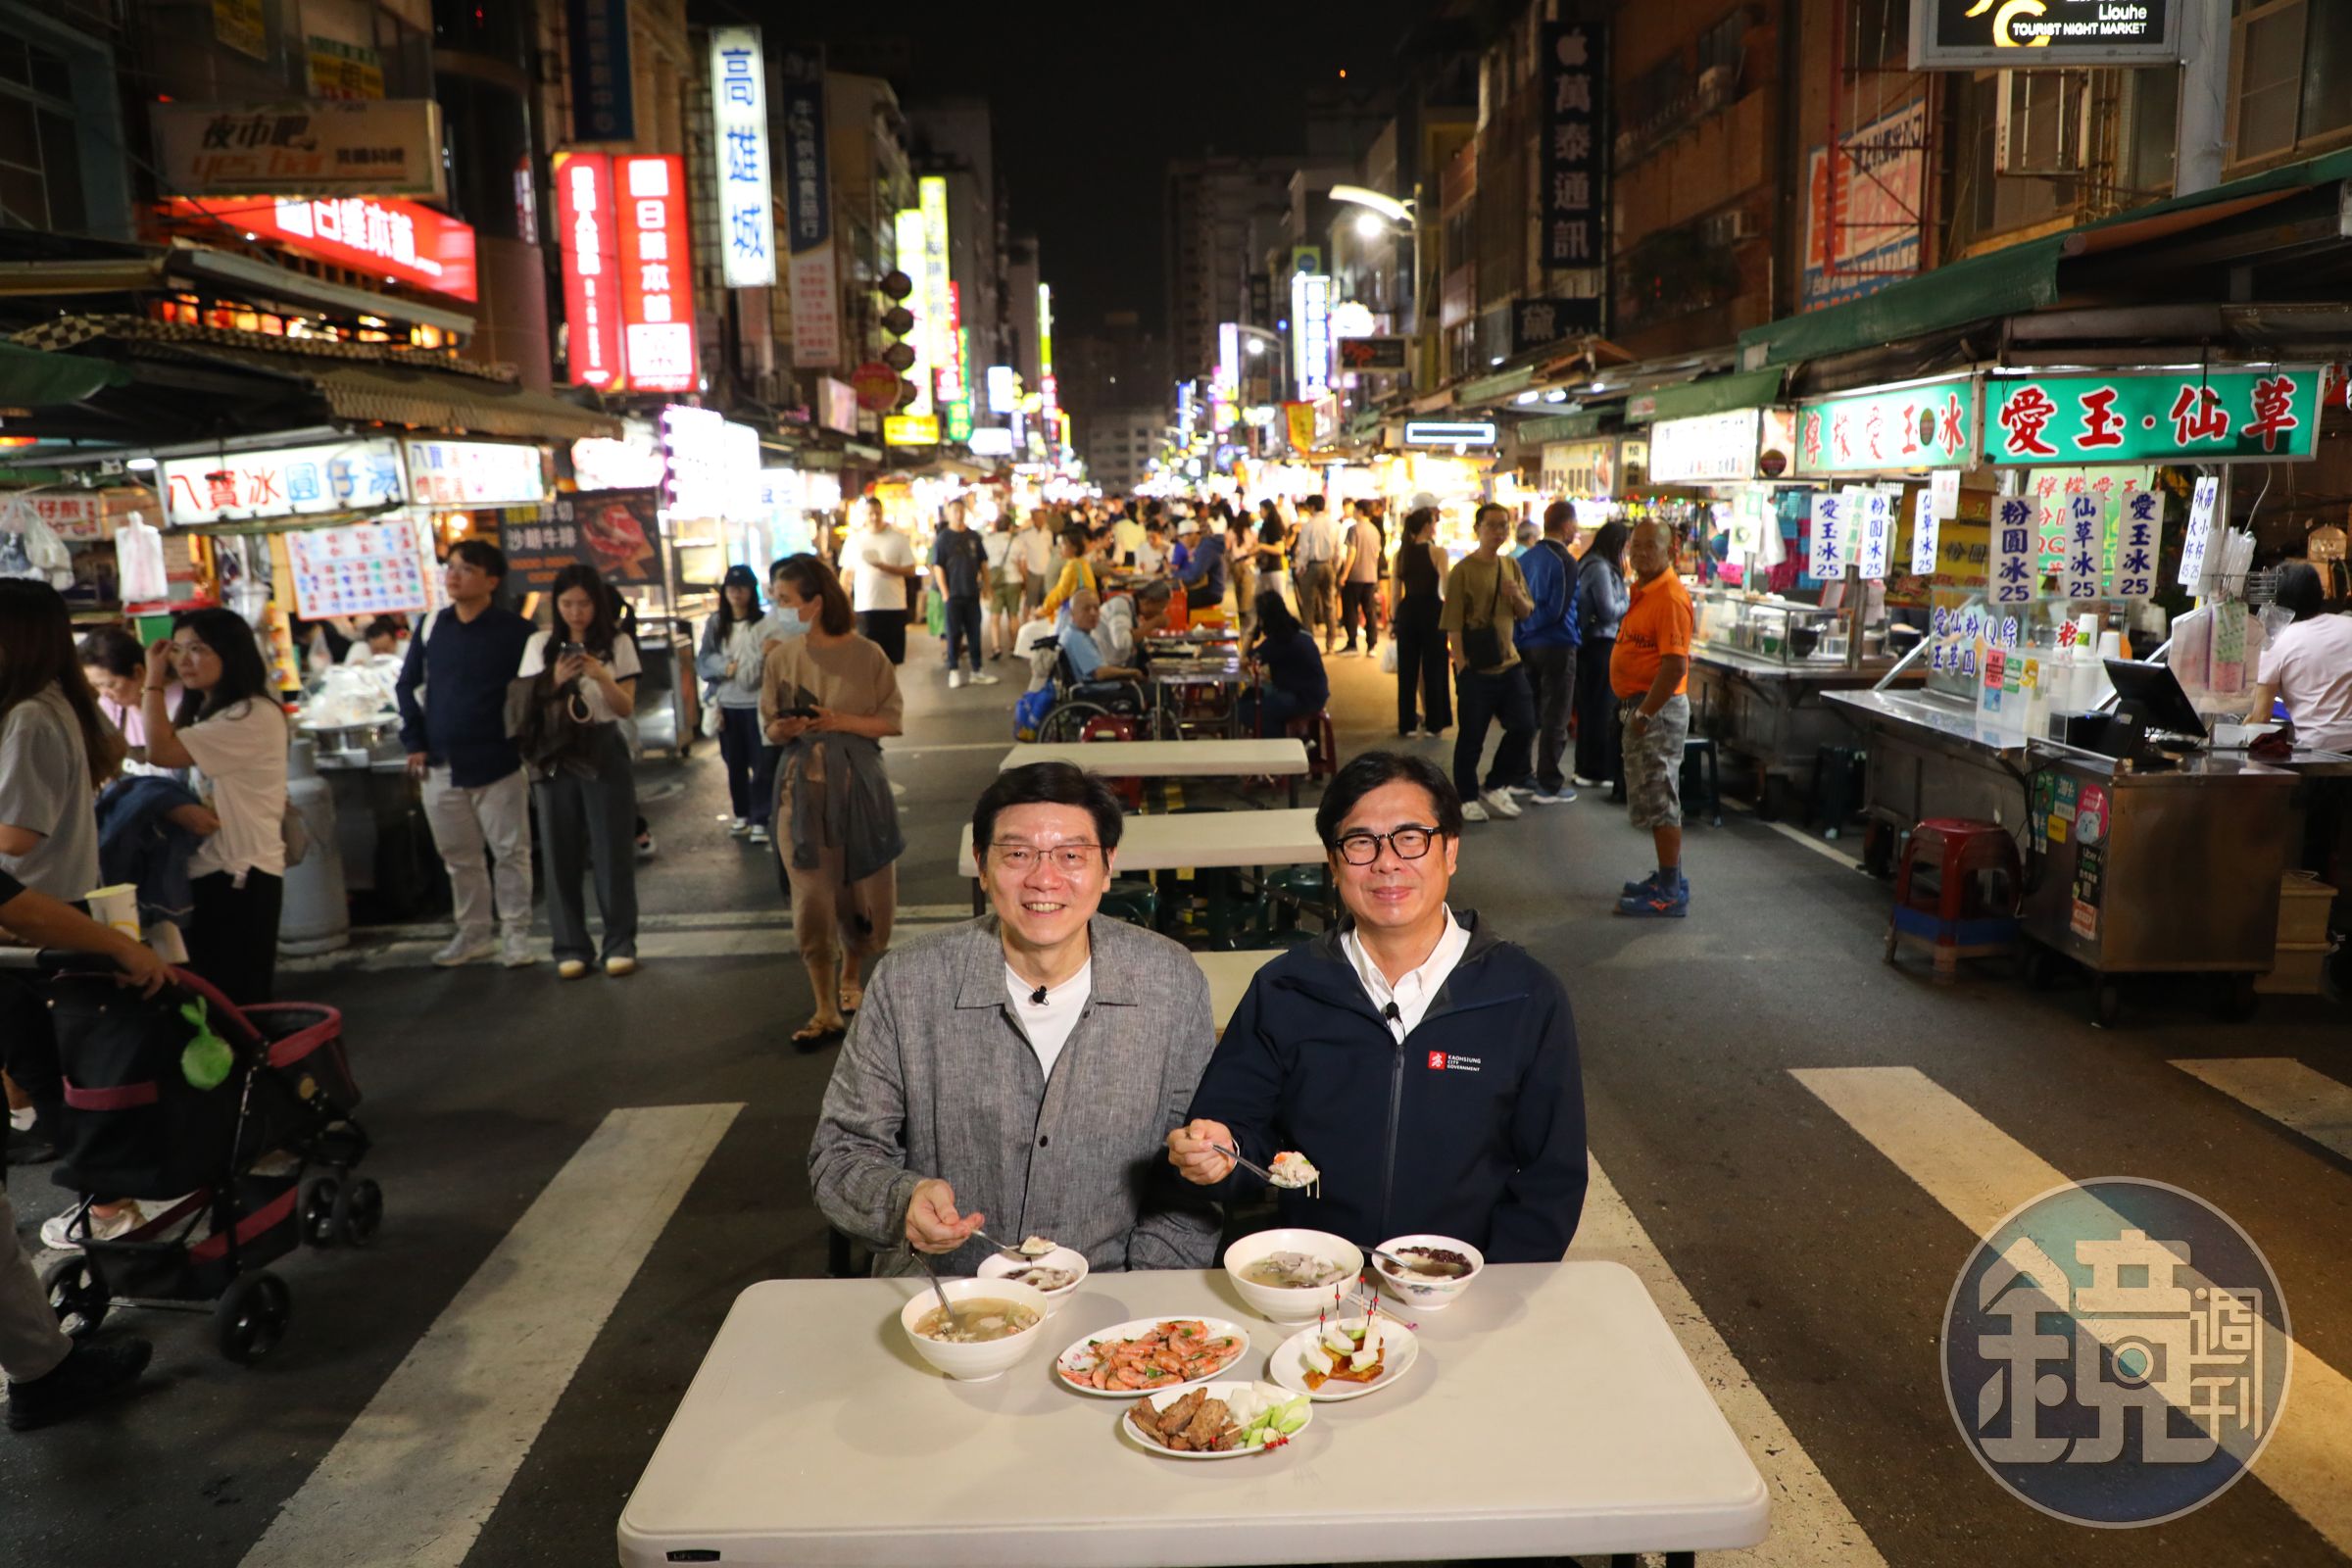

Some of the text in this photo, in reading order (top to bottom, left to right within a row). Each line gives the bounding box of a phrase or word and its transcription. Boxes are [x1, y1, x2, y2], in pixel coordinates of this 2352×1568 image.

[2013, 23, 2147, 36] TOURIST NIGHT MARKET
[720, 48, 765, 259] 高雄城
[1802, 393, 1966, 466] 檸檬愛玉冰
[1816, 498, 1840, 577] 愛玉冰 25
[1865, 496, 1886, 575] 粉圓冰 25
[1918, 559, 1933, 572] 25
[1998, 499, 2032, 602] 粉圓冰 25
[2070, 496, 2097, 599] 仙草冰 25
[2120, 493, 2156, 596] 愛玉冰 25
[1448, 1055, 1481, 1064] KAOHSIUNG
